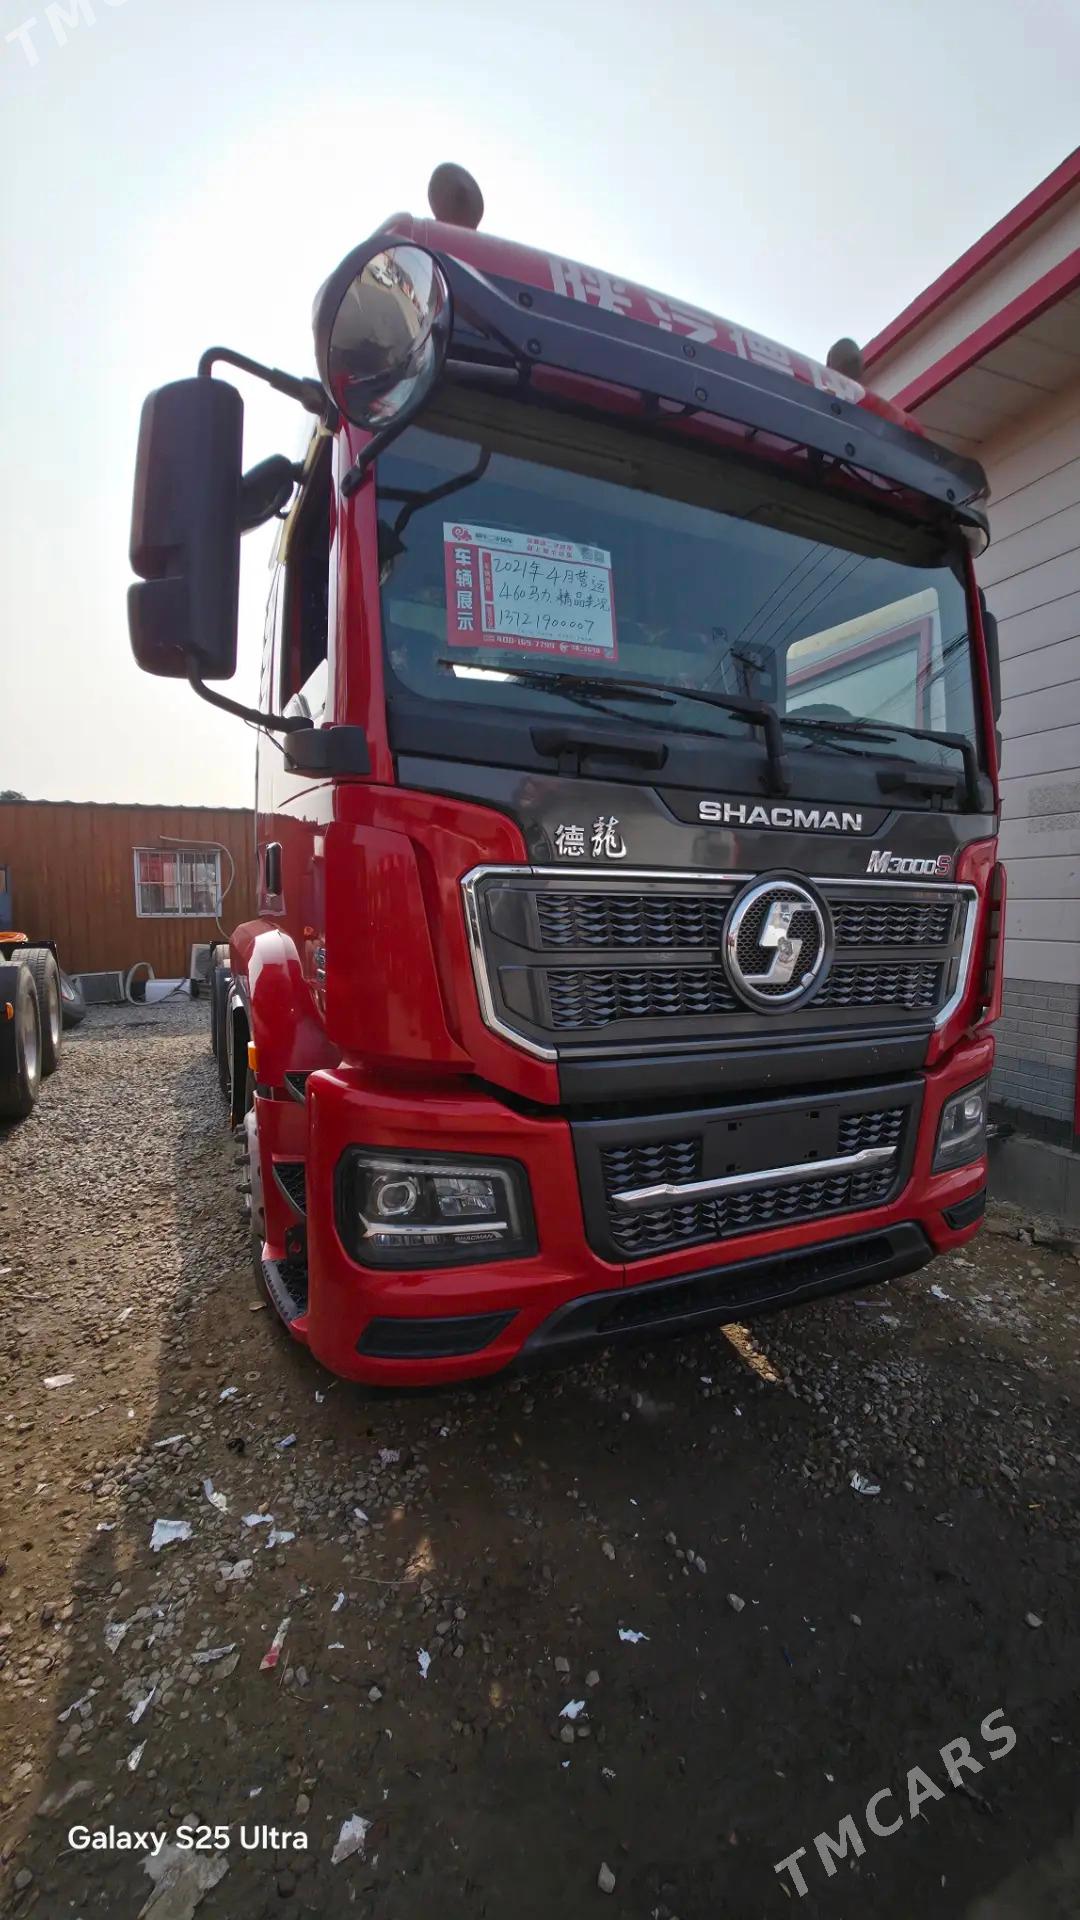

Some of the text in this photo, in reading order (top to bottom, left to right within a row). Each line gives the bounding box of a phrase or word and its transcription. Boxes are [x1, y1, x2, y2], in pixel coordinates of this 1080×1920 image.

[454, 547, 474, 631] 车辆展示
[698, 800, 862, 831] SHACMAN
[555, 815, 627, 858] 德龍
[866, 850, 951, 877] M3000S
